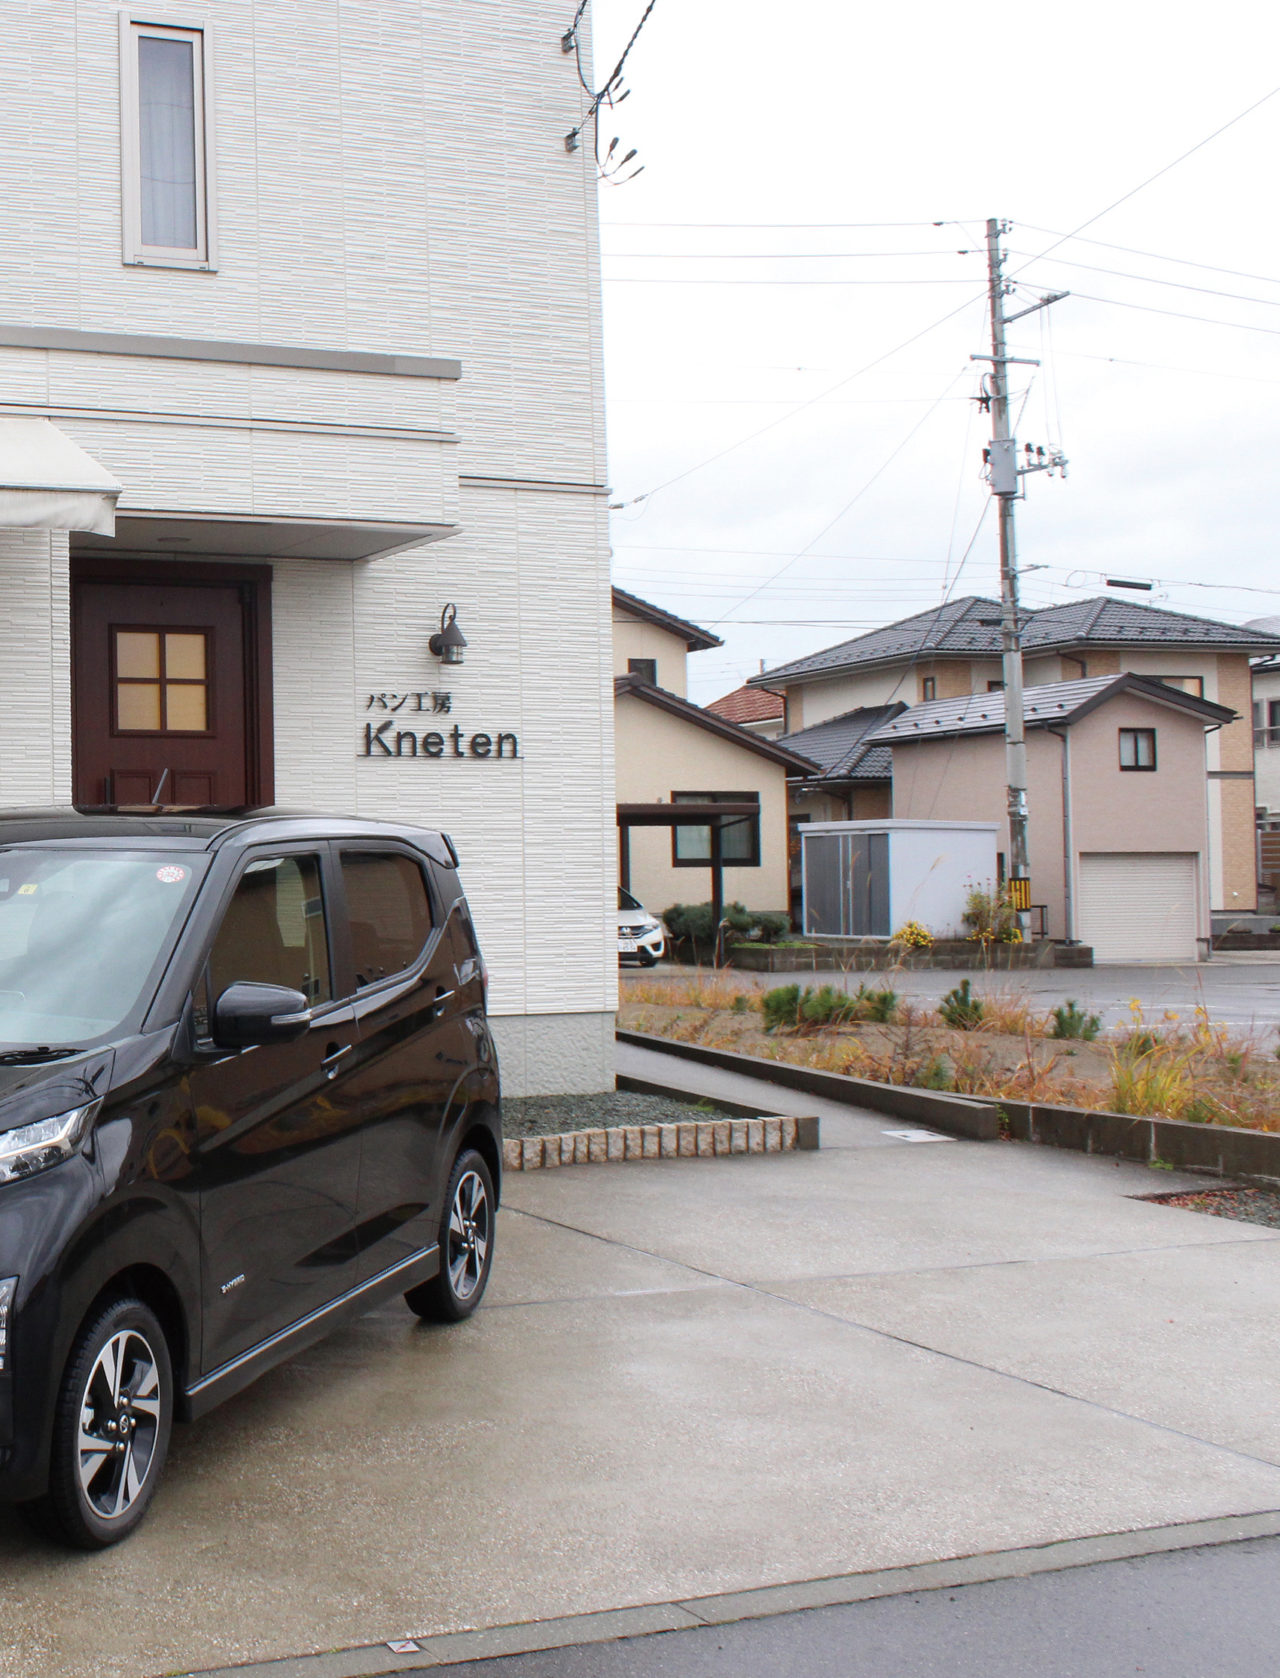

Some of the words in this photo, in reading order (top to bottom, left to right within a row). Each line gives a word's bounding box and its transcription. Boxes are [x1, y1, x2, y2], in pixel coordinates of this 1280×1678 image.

[366, 691, 452, 714] パン工房
[364, 719, 519, 759] Kneten
